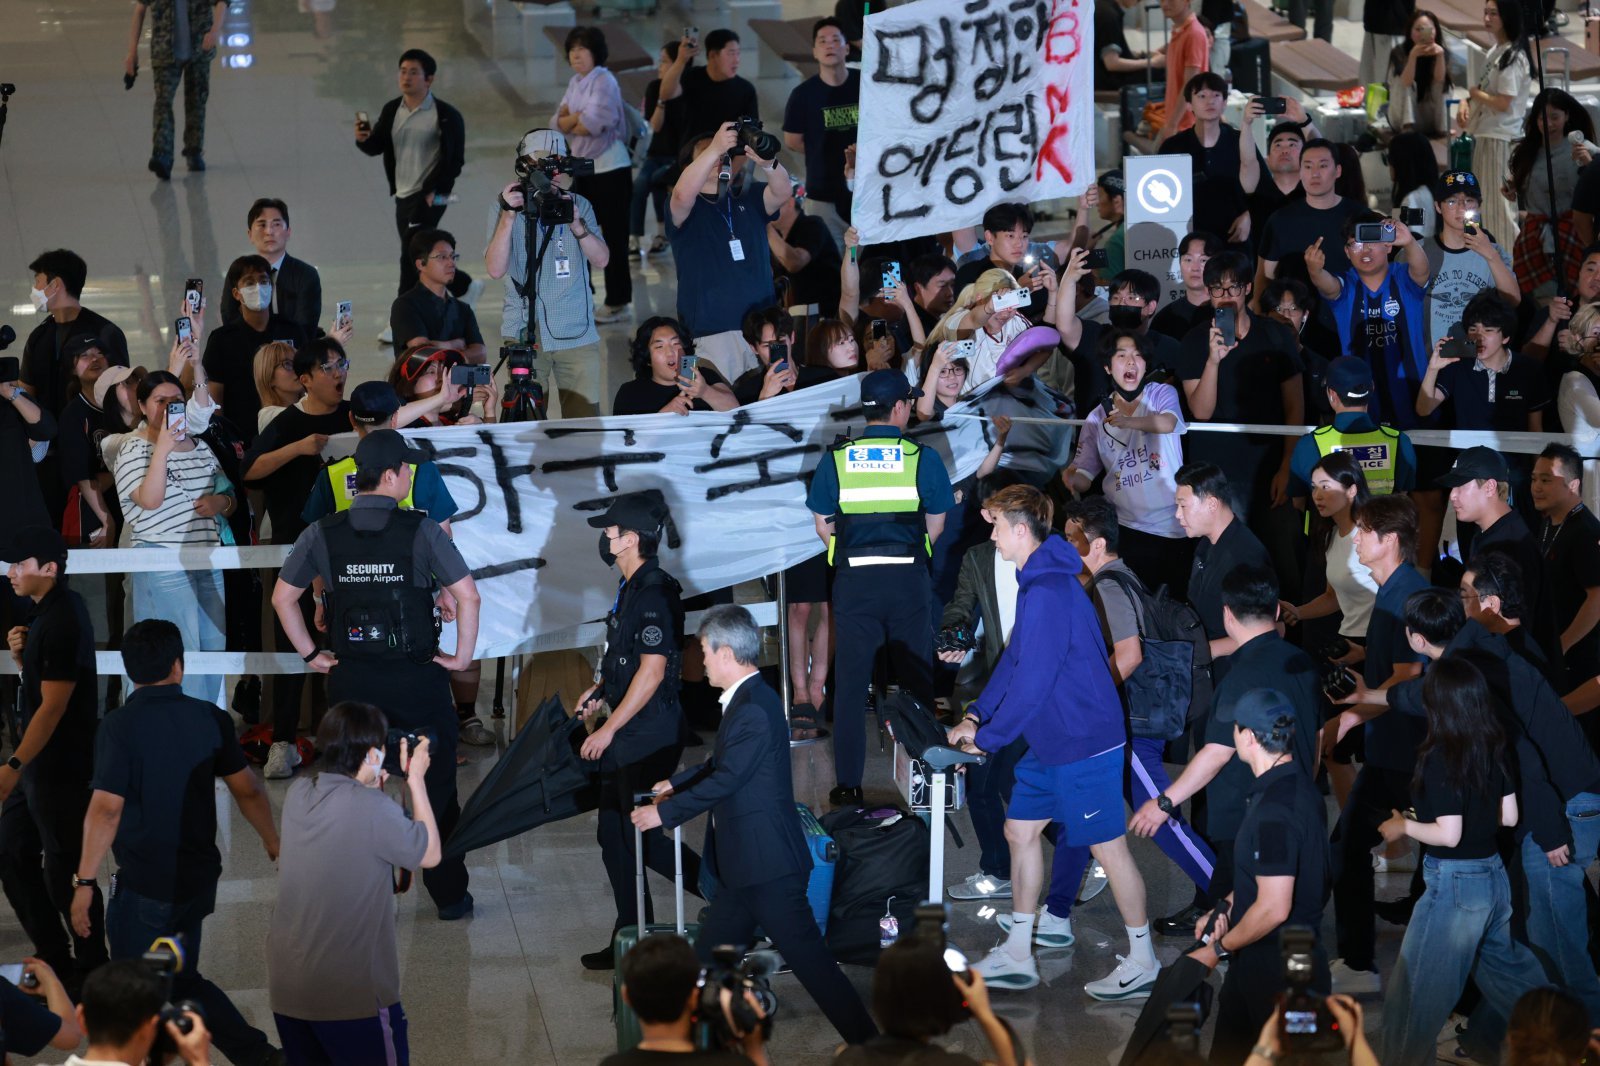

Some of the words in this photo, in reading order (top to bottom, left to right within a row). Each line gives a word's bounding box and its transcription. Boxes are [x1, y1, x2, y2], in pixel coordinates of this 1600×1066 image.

[873, 0, 1048, 123] 멍청한
[1133, 247, 1180, 261] CHARG
[1452, 269, 1463, 280] TO
[346, 563, 395, 575] SECURITY
[338, 574, 371, 583] Incheon
[372, 574, 404, 584] Airport
